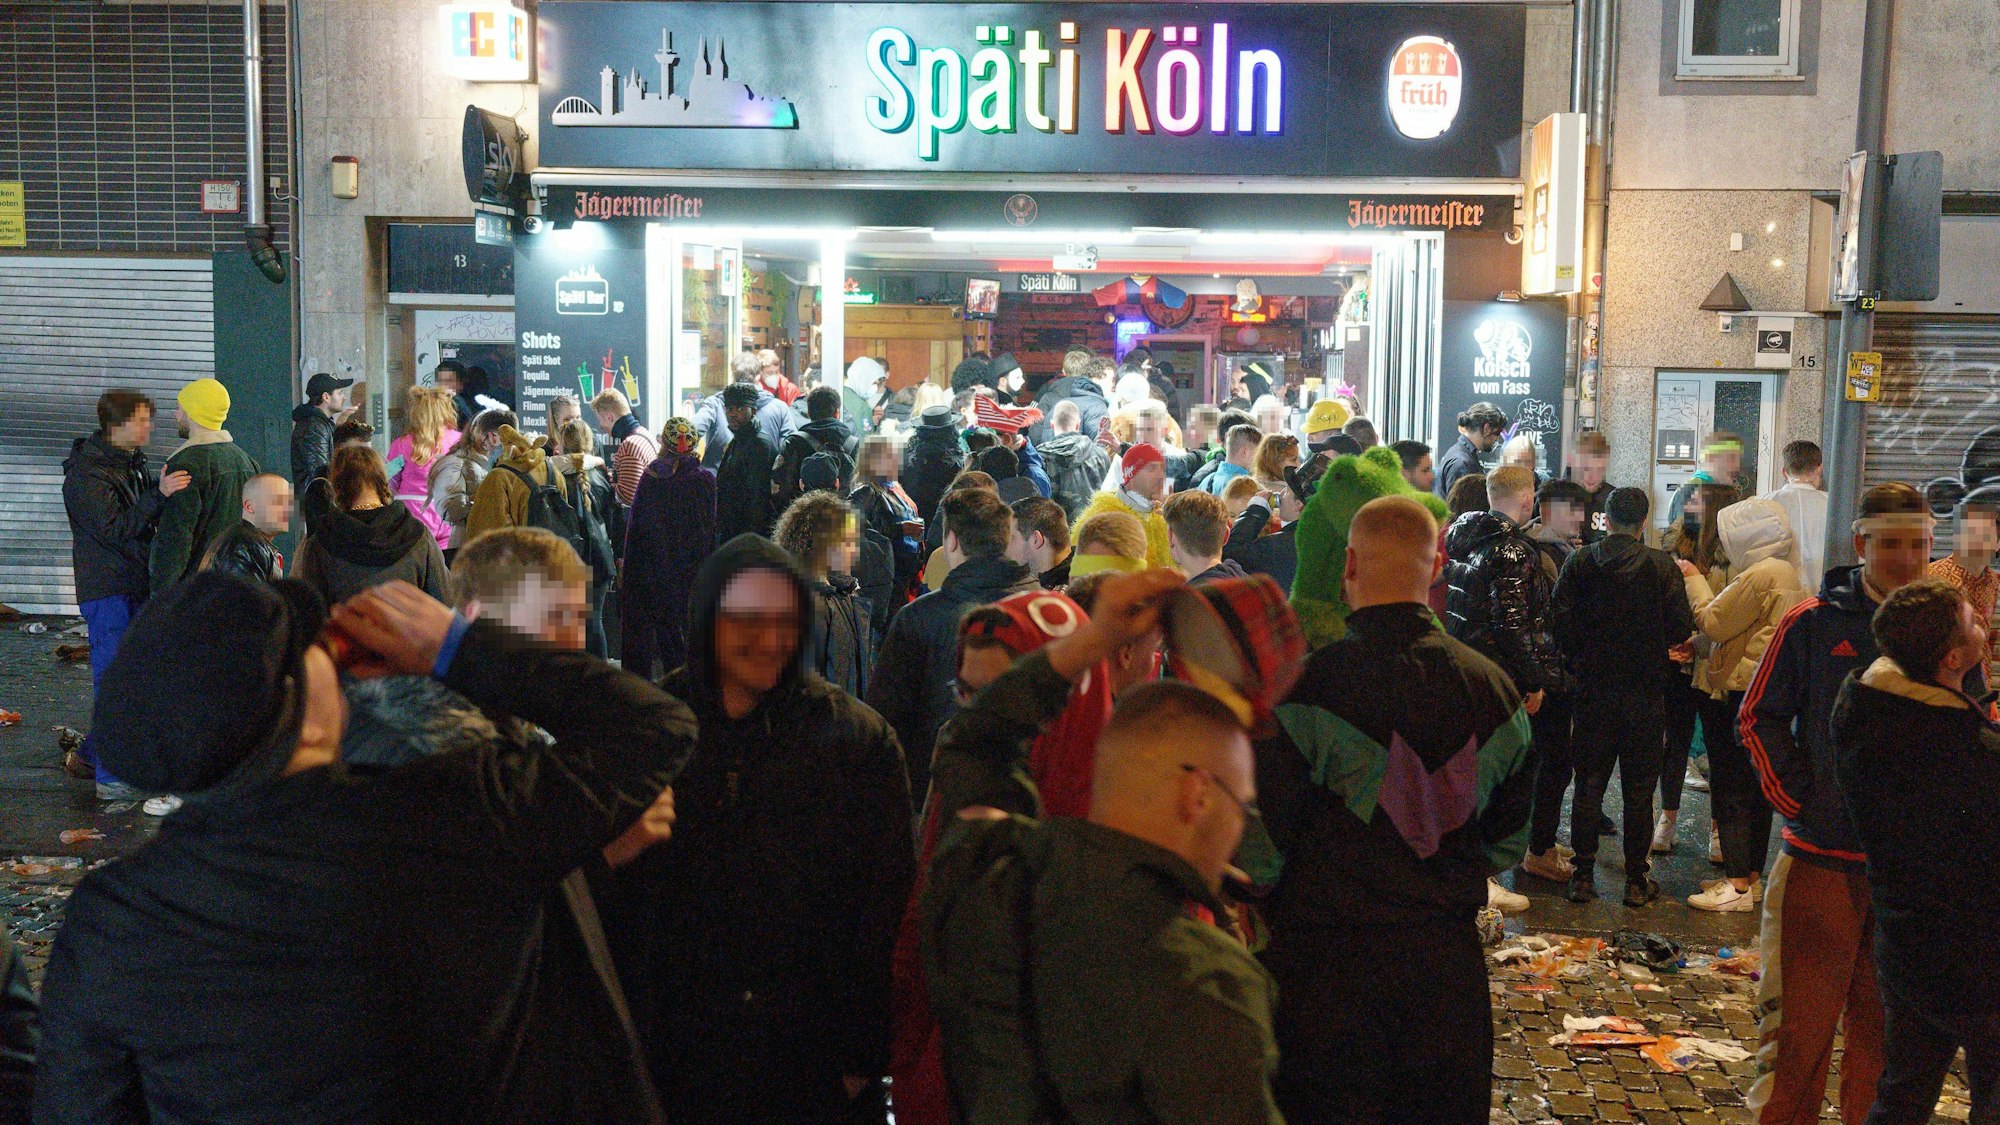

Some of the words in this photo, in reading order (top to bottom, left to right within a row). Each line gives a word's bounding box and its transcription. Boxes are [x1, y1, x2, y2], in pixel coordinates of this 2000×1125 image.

[866, 22, 1078, 161] Späti
[1105, 23, 1284, 135] Köln
[1400, 80, 1448, 108] früh
[454, 254, 467, 268] 13
[1020, 273, 1050, 291] Späti
[1052, 273, 1077, 290] Köln
[1861, 298, 1875, 309] 23
[522, 331, 561, 349] Shots
[522, 354, 542, 367] Späti
[543, 355, 561, 366] Shot
[1474, 357, 1531, 378] Kölsch
[1799, 356, 1816, 367] 15
[523, 371, 550, 383] Tequila
[522, 385, 574, 398] Jägermeister
[1473, 382, 1500, 394] vom
[1502, 380, 1531, 395] Fass
[522, 401, 546, 411] Flimm
[523, 416, 547, 426] Mexik
[1590, 511, 1608, 531] SE
